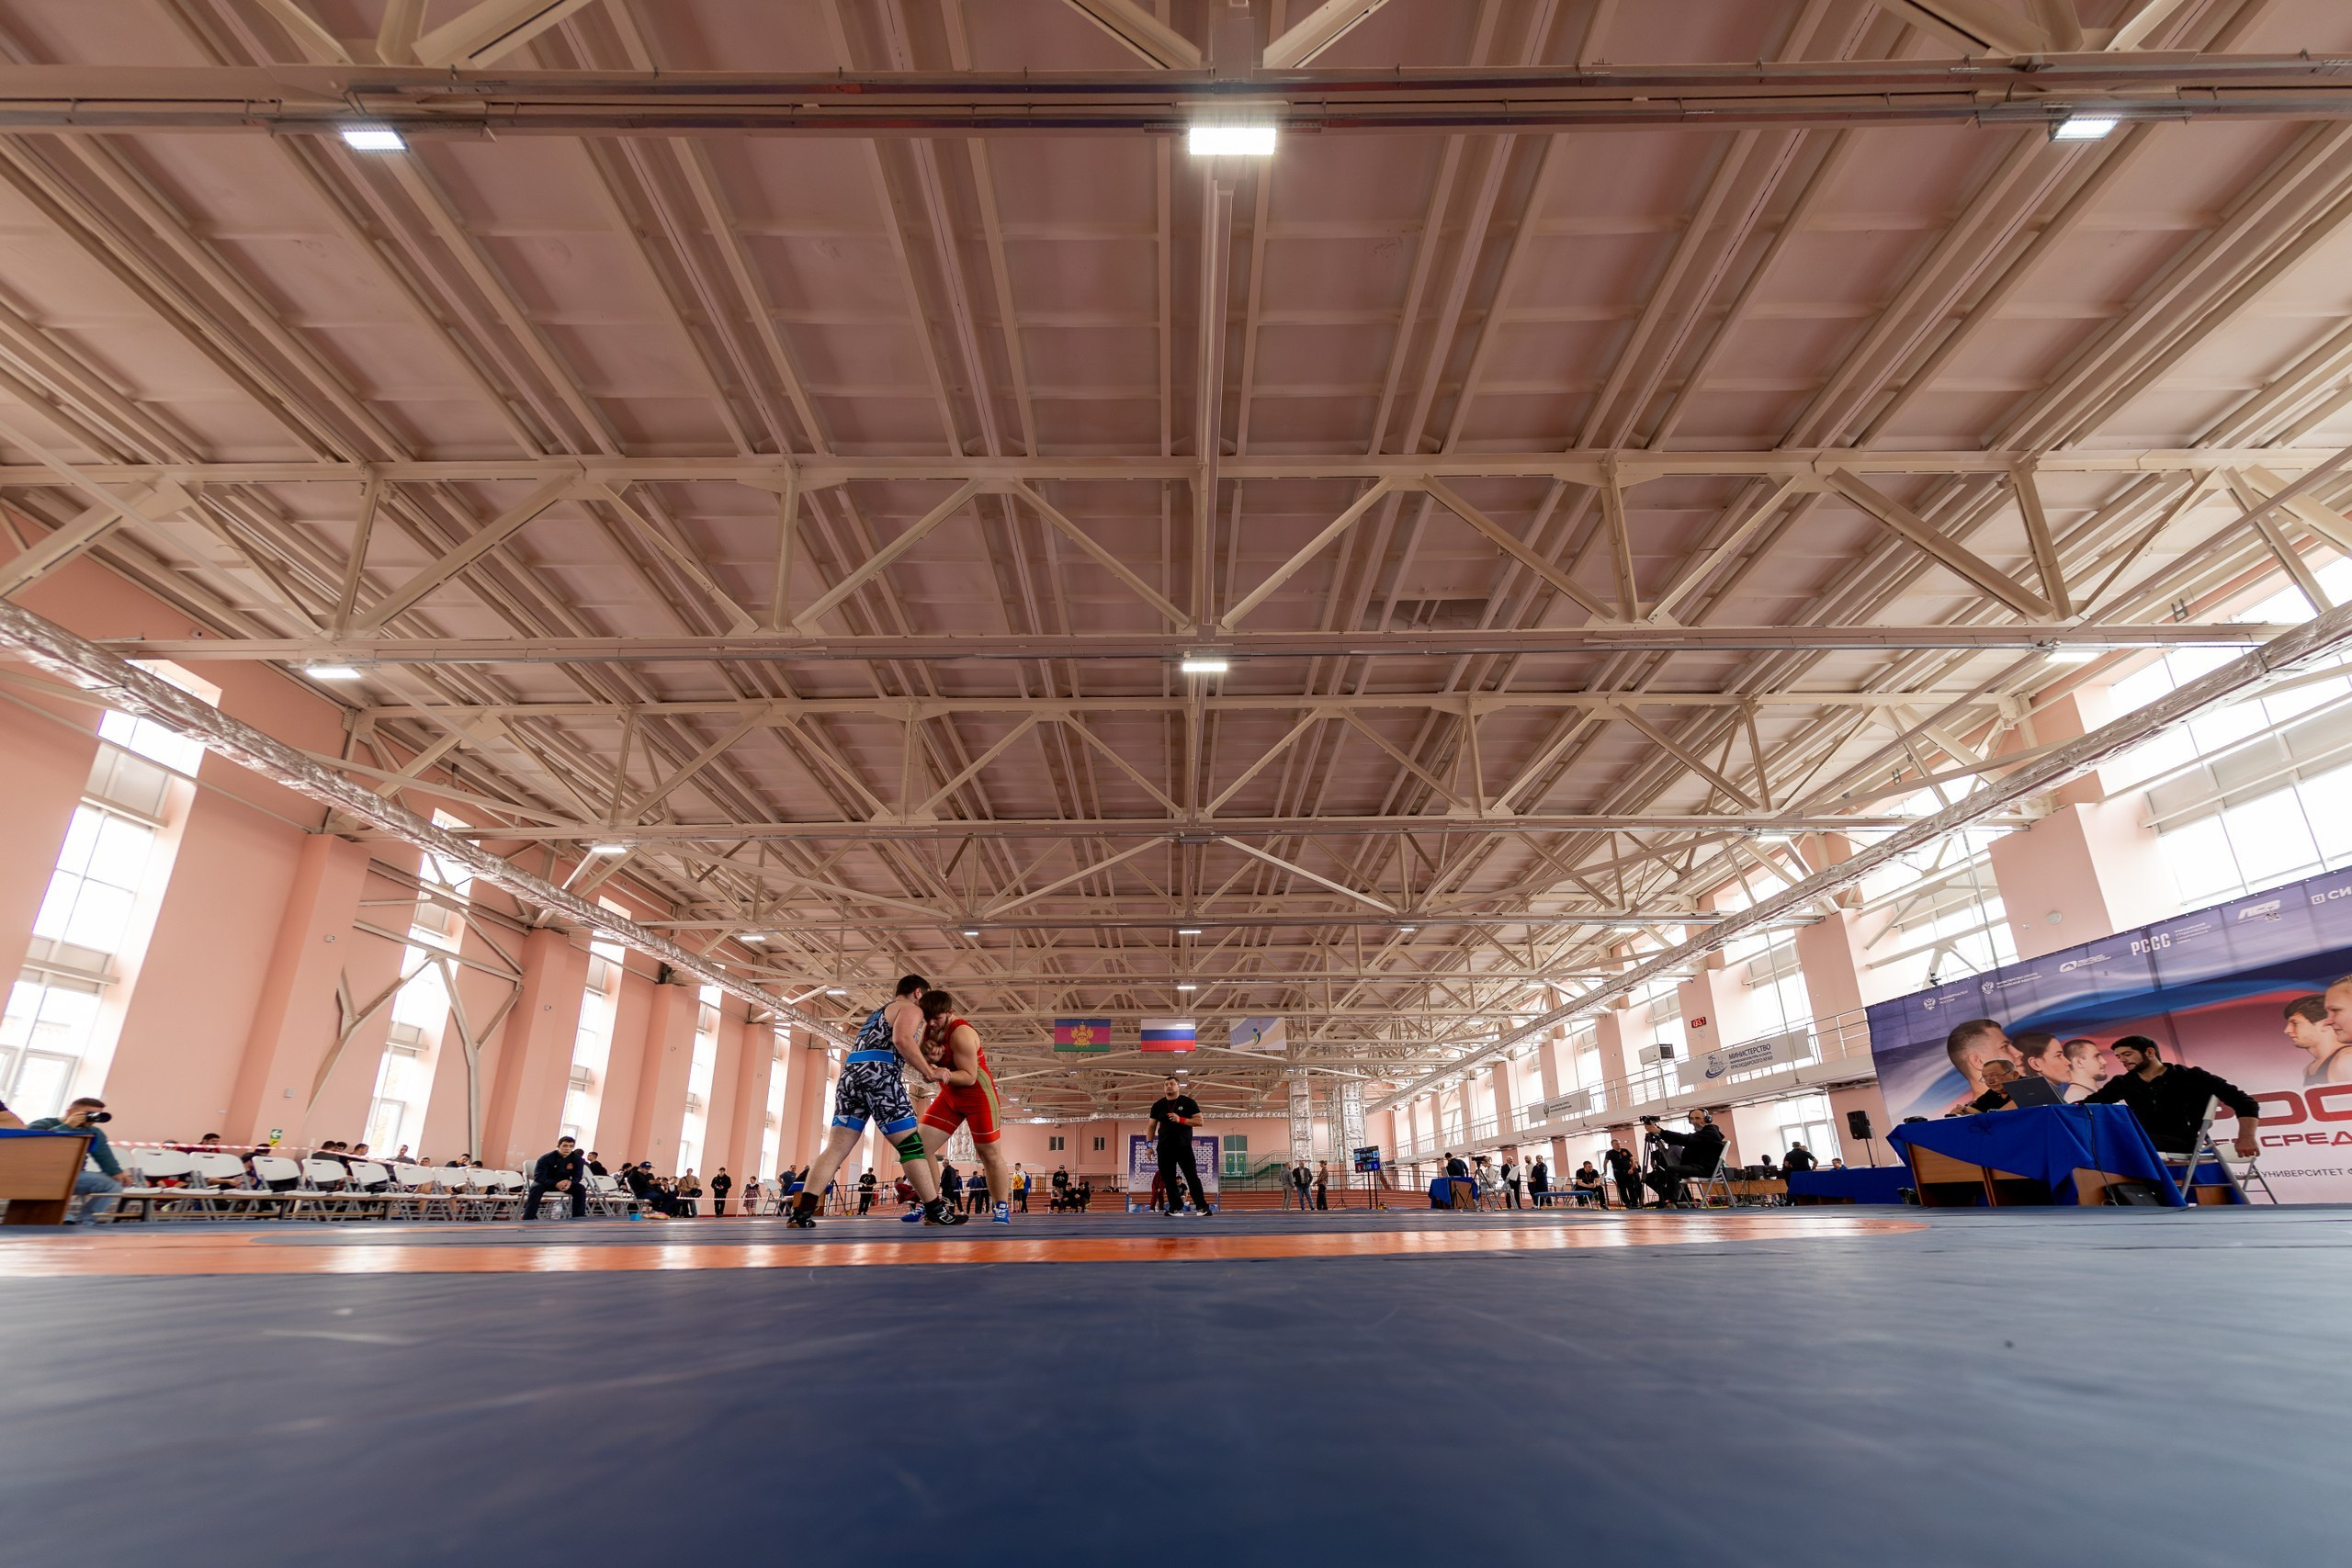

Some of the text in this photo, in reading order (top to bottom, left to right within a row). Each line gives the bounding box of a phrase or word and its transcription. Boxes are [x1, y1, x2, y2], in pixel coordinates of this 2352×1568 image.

[2131, 932, 2171, 955] РССС
[1728, 1043, 1771, 1060] МИНИСТЕРСТВО
[2261, 1168, 2344, 1178] УНИВЕРСИТЕТ
